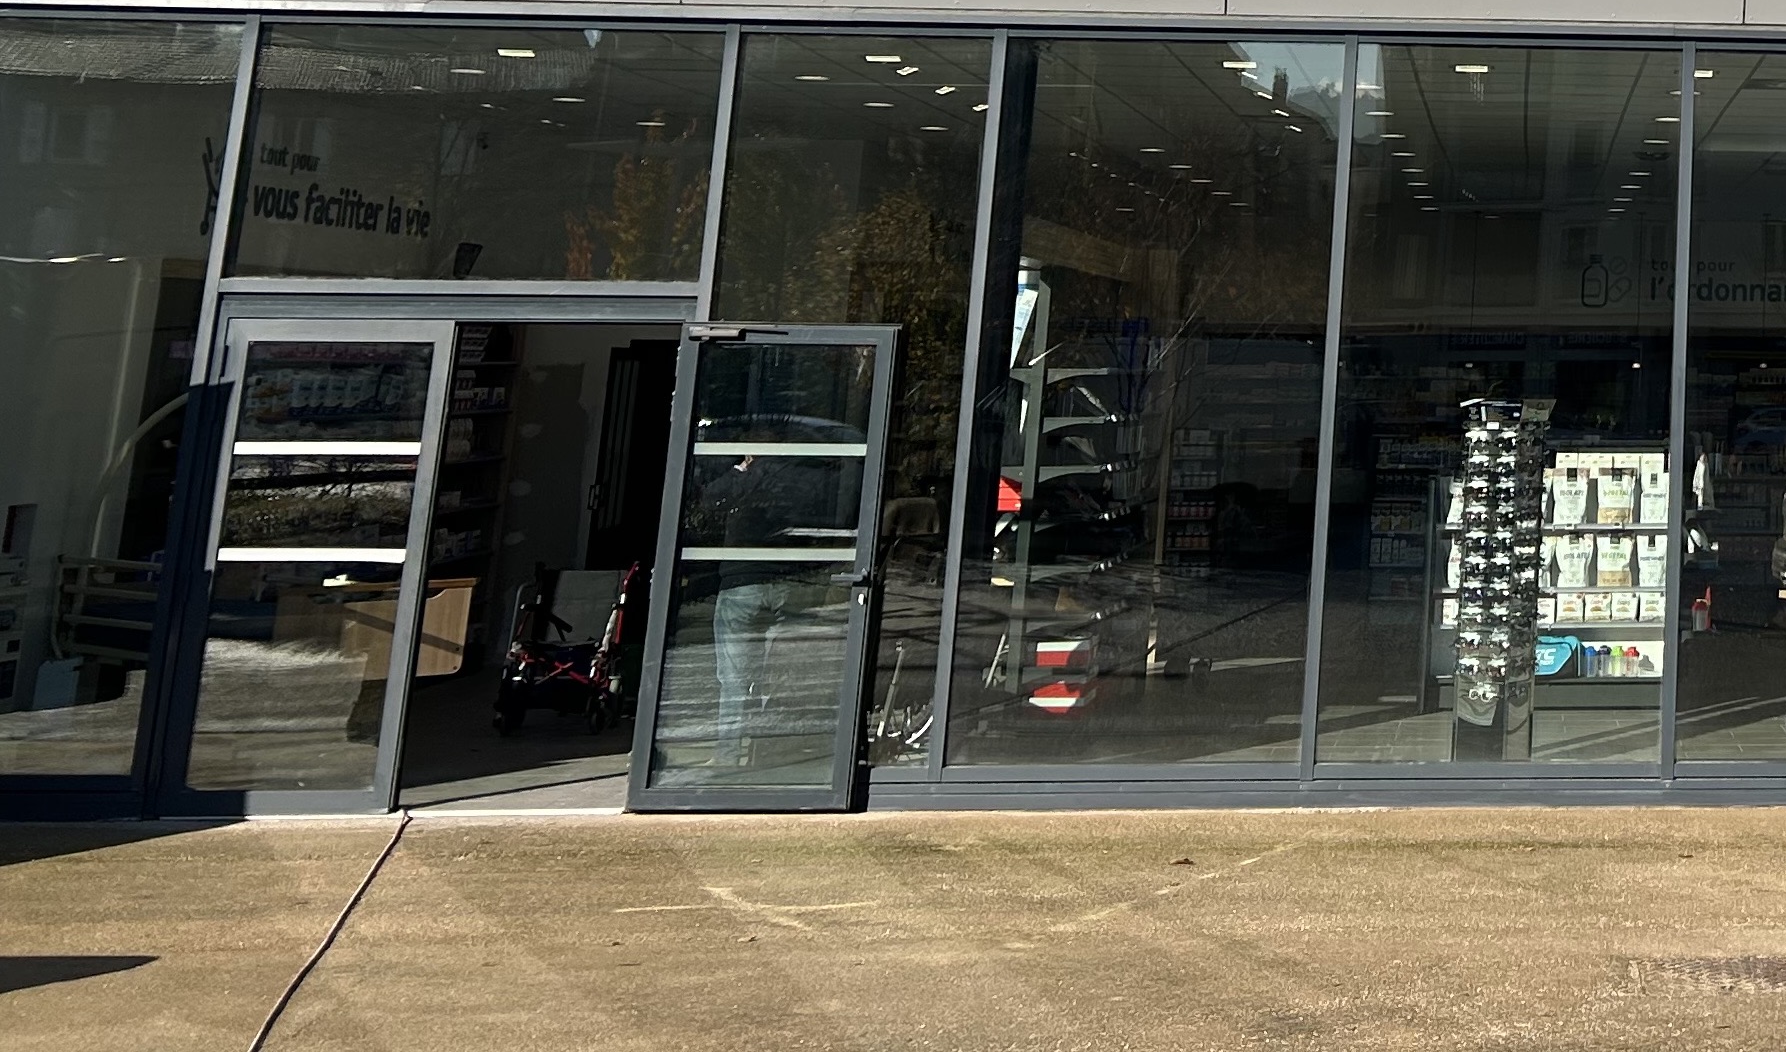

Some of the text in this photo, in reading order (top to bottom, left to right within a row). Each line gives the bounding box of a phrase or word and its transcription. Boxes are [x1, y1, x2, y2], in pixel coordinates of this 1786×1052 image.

[260, 143, 320, 175] tout pour
[253, 182, 431, 238] vous faciliter la vie
[1697, 260, 1735, 275] pour
